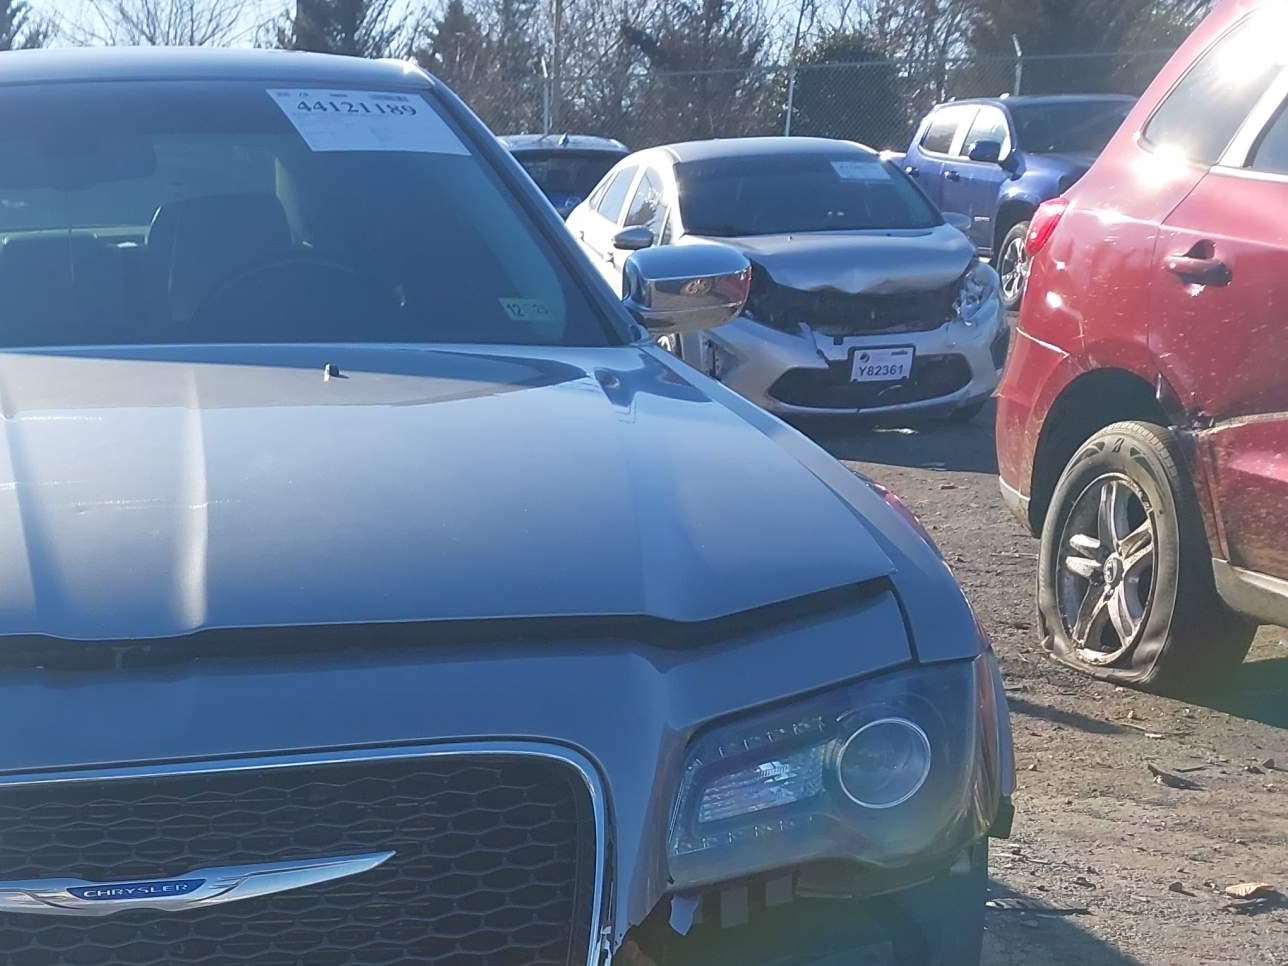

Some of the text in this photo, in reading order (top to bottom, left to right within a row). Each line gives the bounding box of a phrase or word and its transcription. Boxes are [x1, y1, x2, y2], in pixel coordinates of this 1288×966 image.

[297, 100, 417, 116] 44121189
[858, 364, 904, 376] Y82361
[83, 884, 188, 898] CHRYSLER
